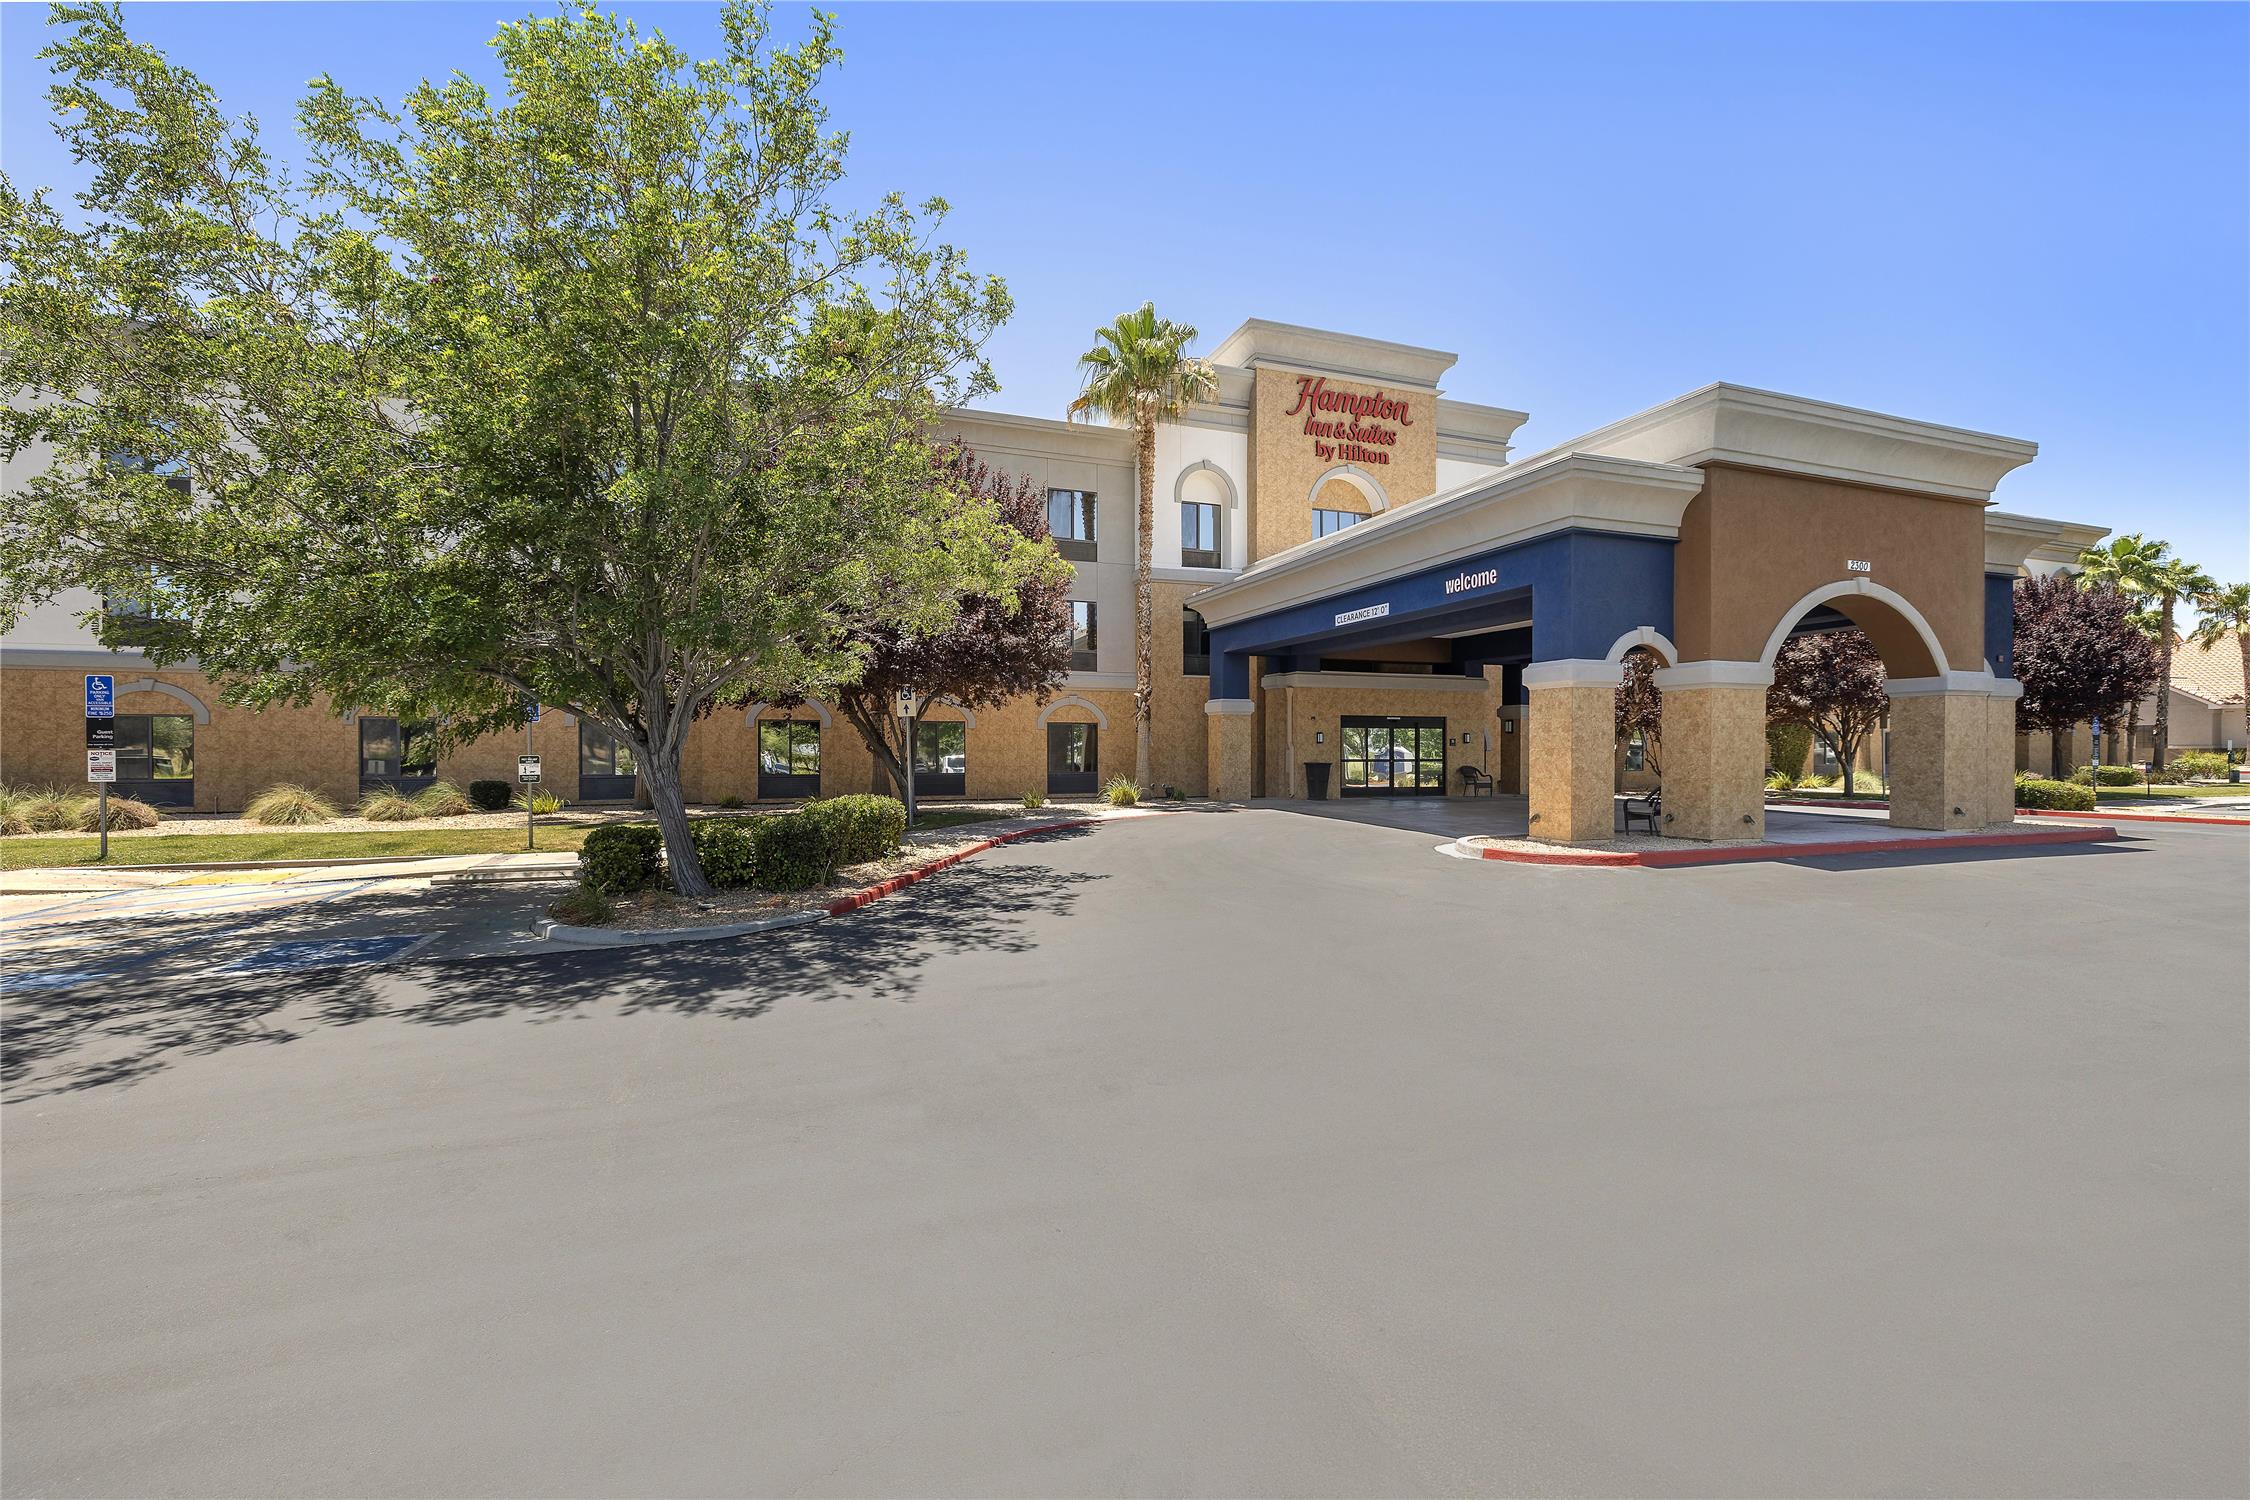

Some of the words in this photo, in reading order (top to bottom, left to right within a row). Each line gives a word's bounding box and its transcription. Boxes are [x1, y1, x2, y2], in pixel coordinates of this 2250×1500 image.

[1286, 377, 1414, 426] Hampton
[1304, 415, 1333, 438] Inn
[1333, 422, 1346, 440] &
[1346, 423, 1397, 446] Suites
[1315, 440, 1336, 463] by
[1338, 443, 1390, 465] Hilton
[1850, 560, 1869, 571] 2300
[1445, 569, 1497, 595] welcome
[1336, 609, 1371, 624] CLEARANCE
